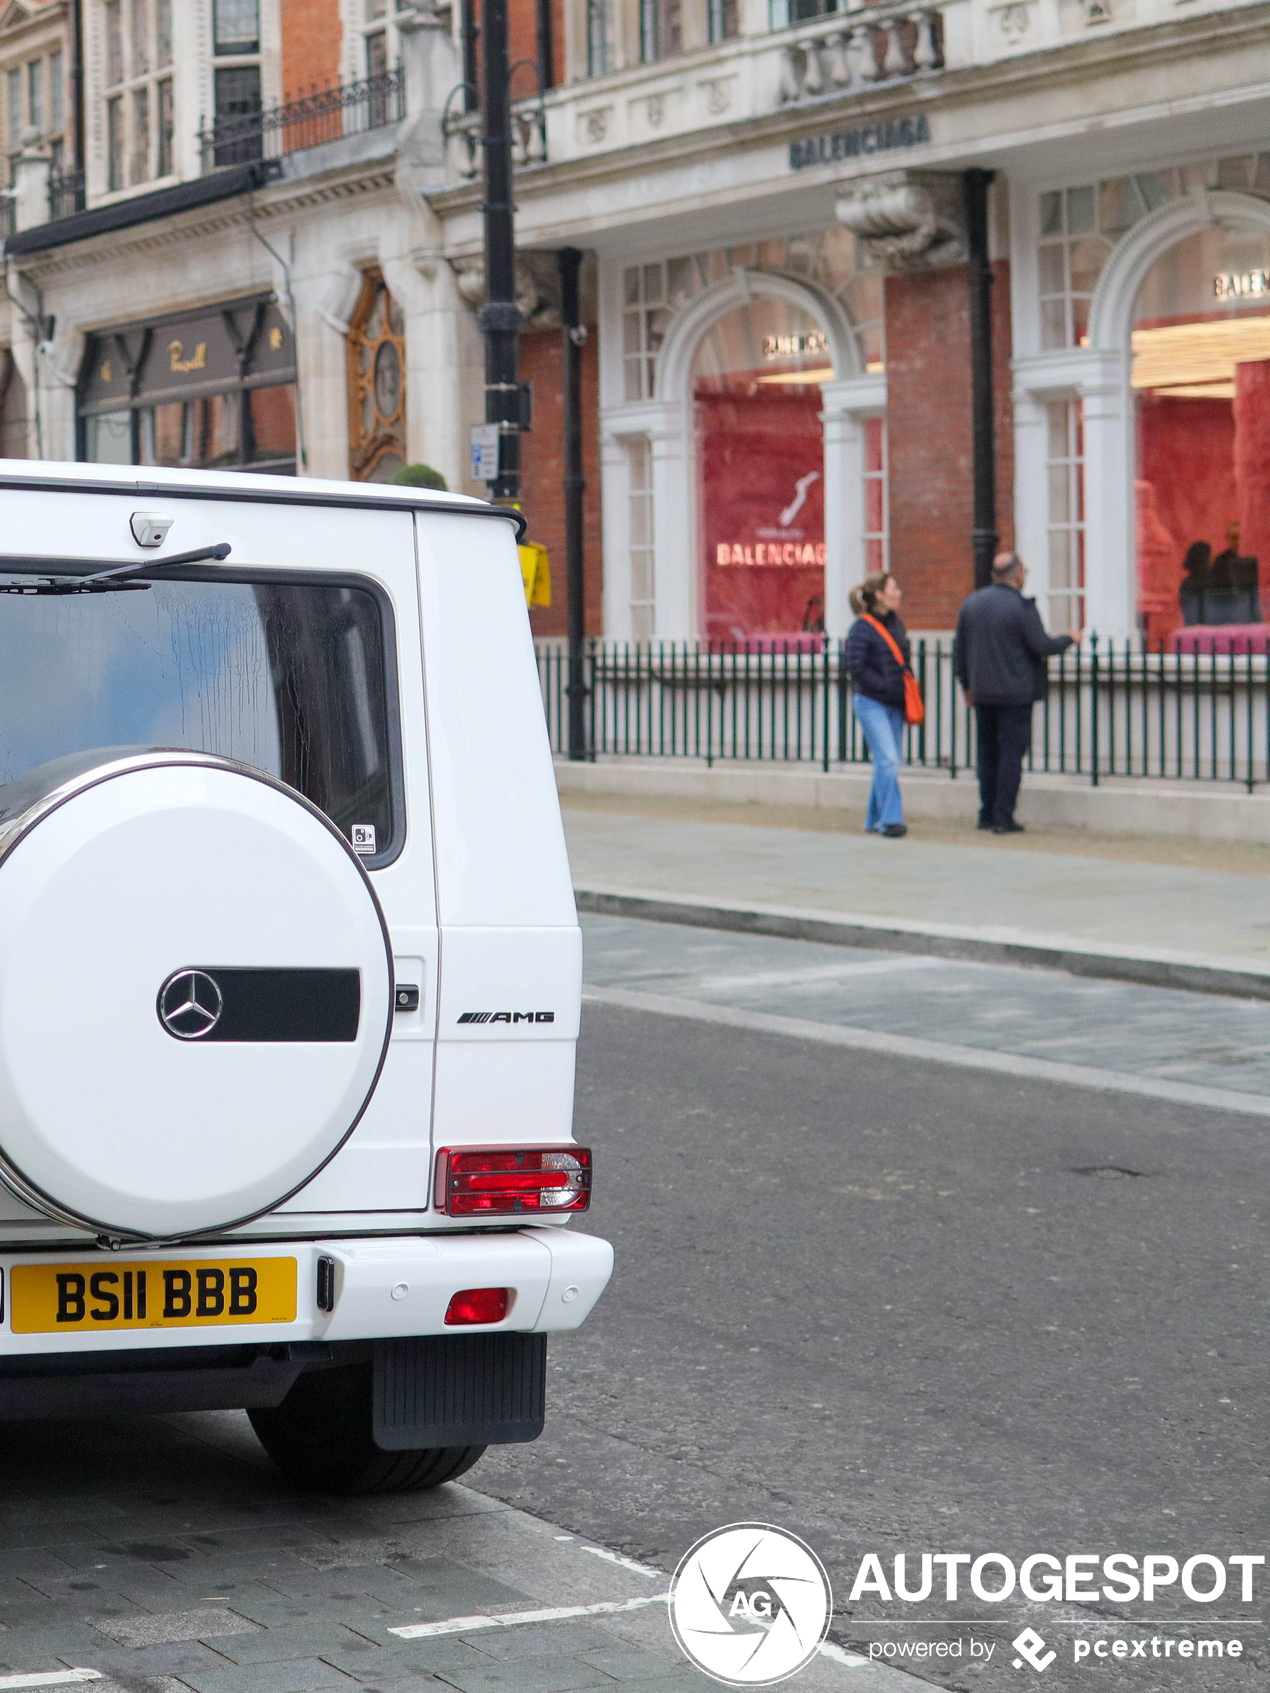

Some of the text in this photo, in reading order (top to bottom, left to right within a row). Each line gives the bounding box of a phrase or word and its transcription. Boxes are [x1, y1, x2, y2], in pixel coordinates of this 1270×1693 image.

[790, 114, 931, 170] BALENCIAGA
[488, 1012, 555, 1023] AMG
[56, 1267, 258, 1323] BS11 BBB
